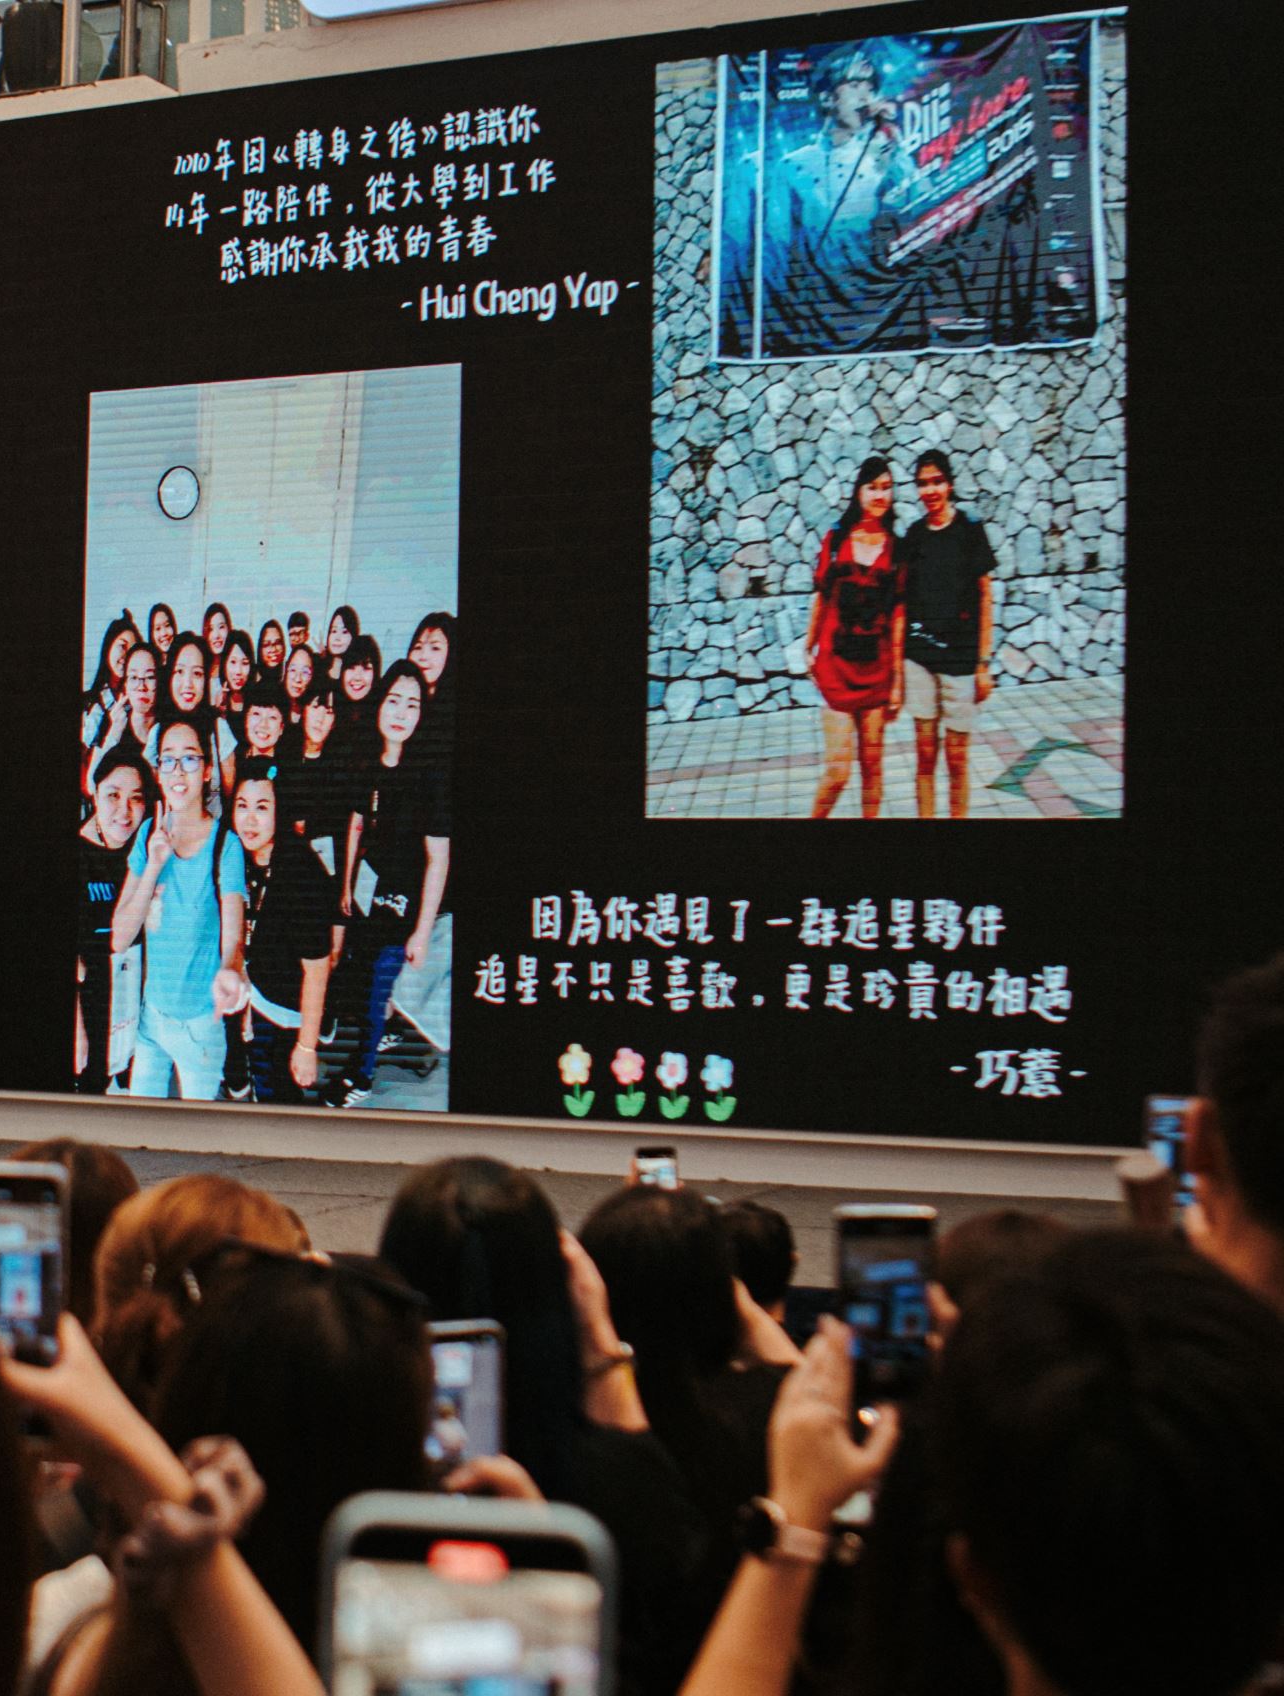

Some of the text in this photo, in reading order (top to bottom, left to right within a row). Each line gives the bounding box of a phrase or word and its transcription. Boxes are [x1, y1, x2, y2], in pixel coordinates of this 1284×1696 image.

[987, 111, 1035, 162] 2015
[220, 214, 498, 284] 感謝你承載我的青春
[473, 279, 557, 322] Cheng
